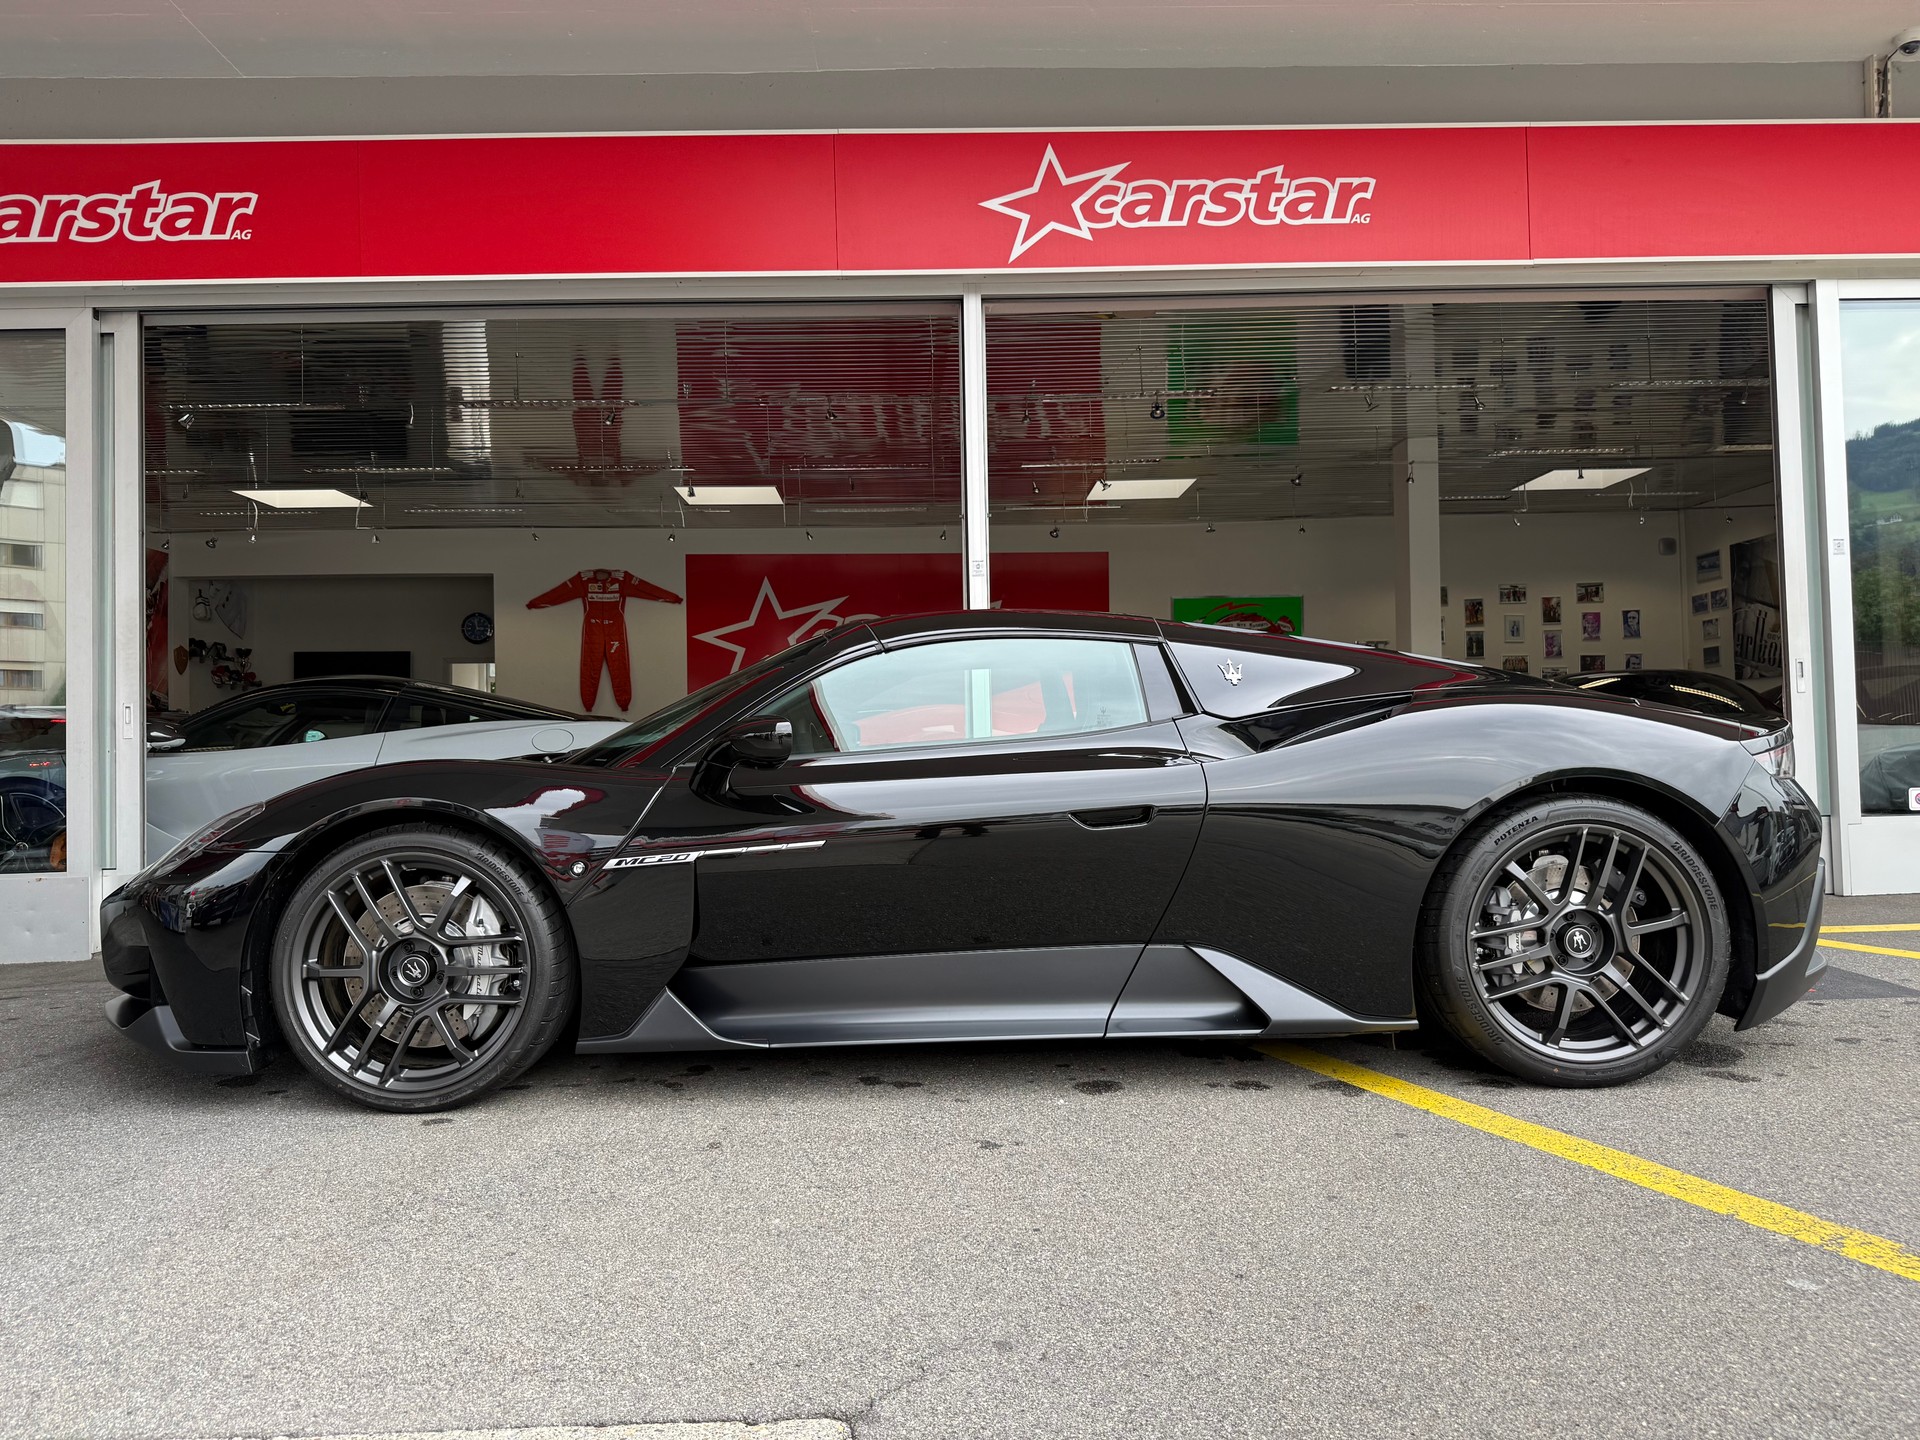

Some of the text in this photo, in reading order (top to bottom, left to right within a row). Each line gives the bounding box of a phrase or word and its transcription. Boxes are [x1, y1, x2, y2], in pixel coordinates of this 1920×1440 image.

[0, 179, 258, 243] arstar AG
[1081, 165, 1376, 228] carstar AG
[610, 641, 620, 653] 7
[1493, 815, 1539, 846] POTENZA
[474, 852, 525, 897] BRIDGESTONE
[614, 853, 691, 867] MC20
[1671, 841, 1719, 911] BRIDGESTONE
[476, 944, 484, 996] Masrati
[1455, 976, 1506, 1046] BRIDGESTONE
